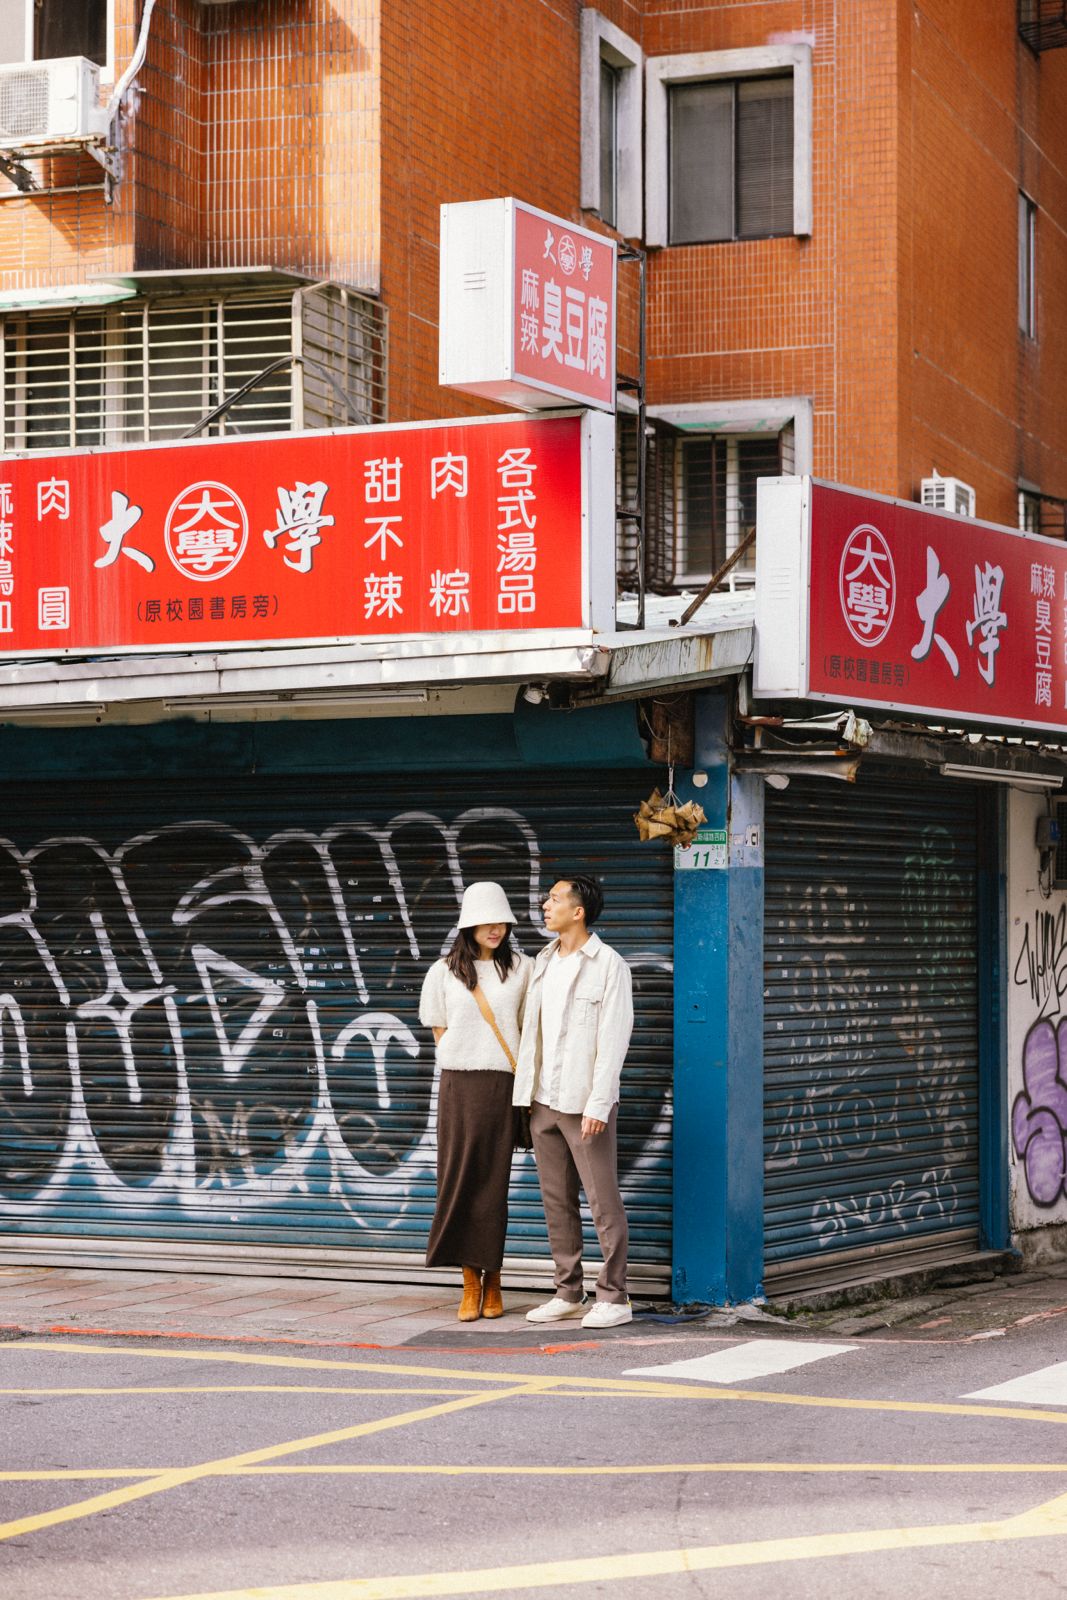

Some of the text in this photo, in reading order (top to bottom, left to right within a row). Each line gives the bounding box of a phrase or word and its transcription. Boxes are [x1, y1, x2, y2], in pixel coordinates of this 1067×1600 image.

[520, 268, 608, 379] 麻辣 臭豆腐
[37, 476, 70, 631] 肉圓
[177, 490, 239, 571] 大學
[364, 456, 404, 620] 甜不辣
[429, 451, 470, 617] 肉粽
[497, 447, 538, 614] 各式湯品
[845, 535, 891, 634] 大學
[911, 546, 1008, 687] 大學
[693, 851, 710, 867] 11
